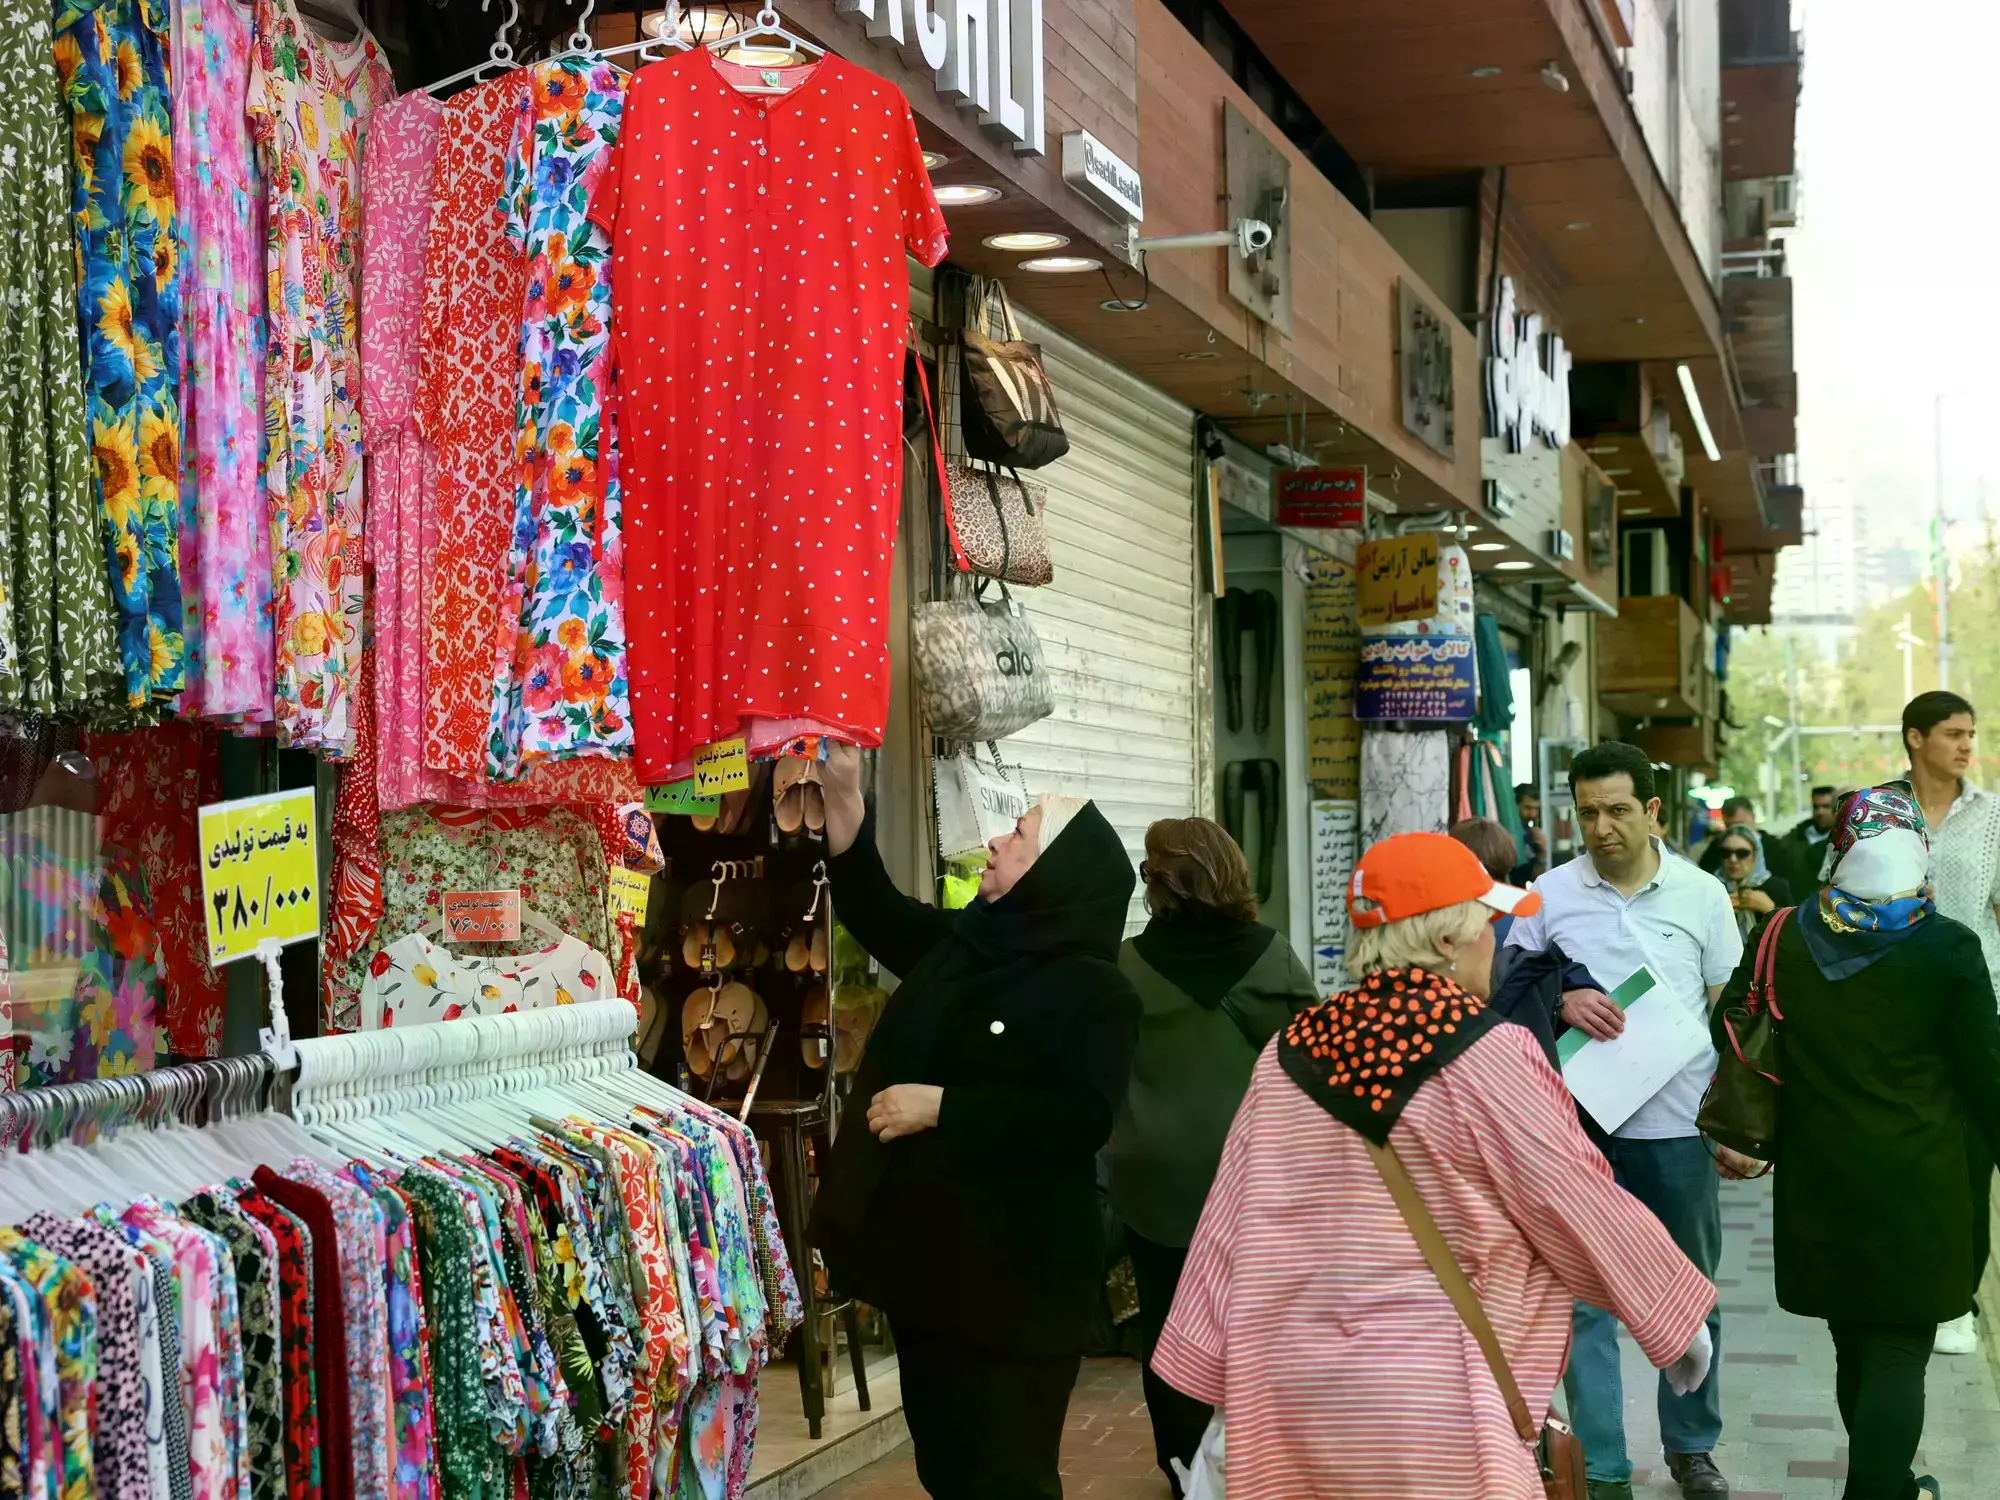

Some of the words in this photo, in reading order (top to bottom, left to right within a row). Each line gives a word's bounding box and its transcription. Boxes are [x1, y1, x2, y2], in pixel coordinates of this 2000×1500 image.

[996, 637, 1033, 677] alo
[1395, 640, 1433, 661] خواب
[1432, 640, 1472, 661] کالای
[696, 749, 719, 766] تولیدی
[720, 746, 736, 760] قیمت
[698, 767, 744, 788] ۷۰۰/۰۰۰
[258, 817, 292, 851] قیمت
[296, 821, 308, 846] به
[208, 827, 255, 869] تولیدی
[213, 875, 311, 936] ۳۸۰/۰۰۰
[448, 898, 479, 911] تولیدی
[448, 916, 516, 934] ۷۶۰/۰۰۰
